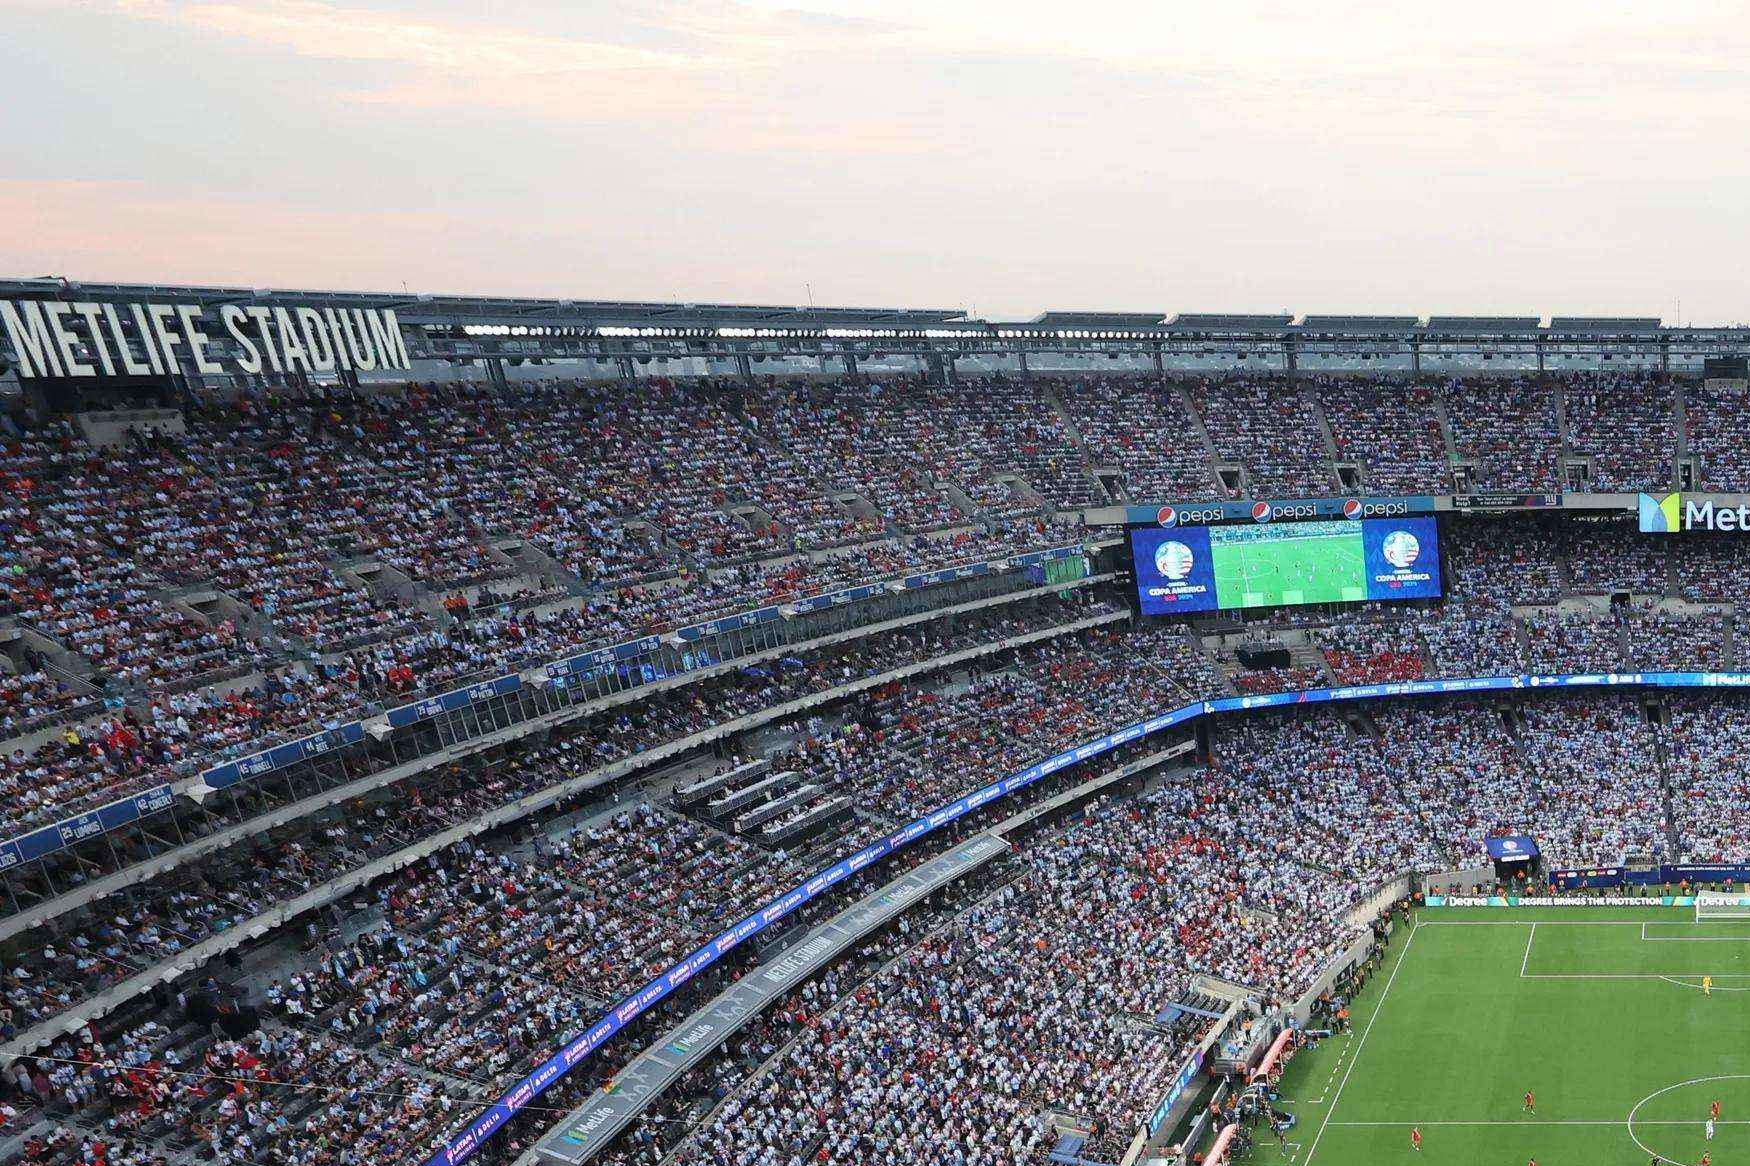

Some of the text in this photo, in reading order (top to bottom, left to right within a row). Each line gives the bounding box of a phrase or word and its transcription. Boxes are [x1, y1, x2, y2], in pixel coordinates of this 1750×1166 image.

[1, 300, 411, 377] METLIFE STADIUM
[1179, 506, 1224, 526] pepsi
[1272, 502, 1317, 521] pepsi
[1363, 500, 1408, 518] pepsi
[1149, 588, 1171, 596] COPA
[1450, 897, 1488, 907] Degree
[1518, 898, 1663, 906] DEGREE BRINGS THE PROTECTION
[763, 956, 801, 983] METLIFE
[679, 1023, 714, 1047] MetLife
[483, 1113, 500, 1132] DELTA
[577, 1107, 615, 1134] MetLife
[452, 1134, 473, 1155] LATAM
